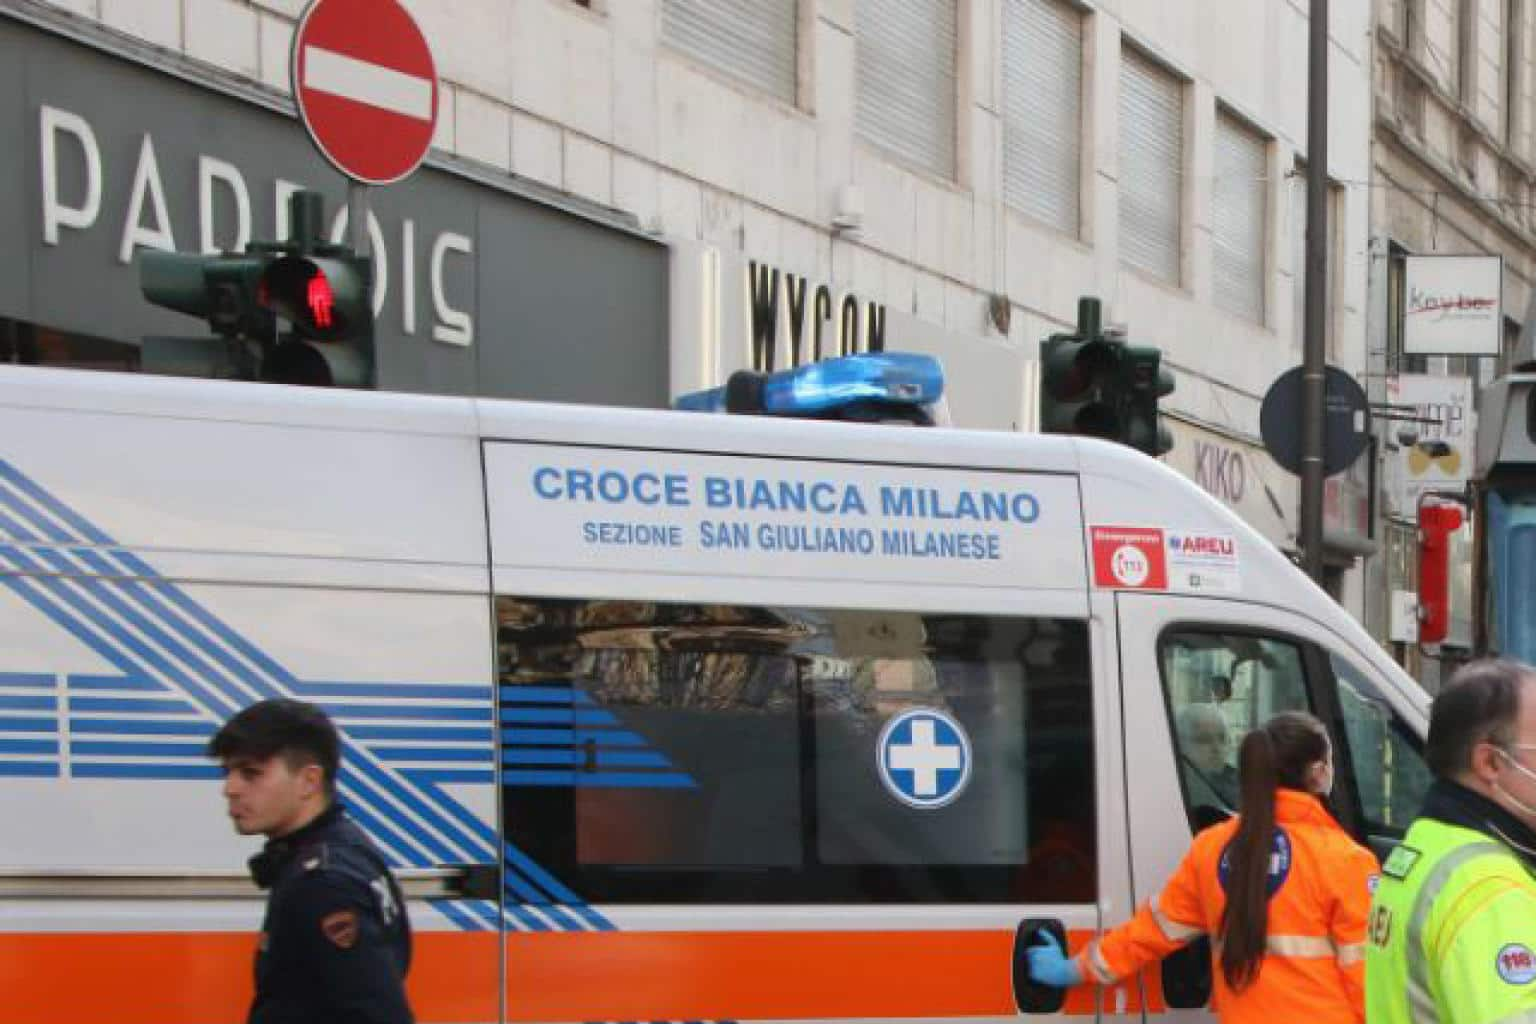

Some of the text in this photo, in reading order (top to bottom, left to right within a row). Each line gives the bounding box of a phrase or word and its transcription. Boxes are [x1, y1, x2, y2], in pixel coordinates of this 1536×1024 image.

[533, 467, 1041, 524] CROCE BIANCA MILANO
[1194, 440, 1244, 503] KIKO
[582, 520, 1001, 561] SEZIONE SAN GIULIANO MILANESE
